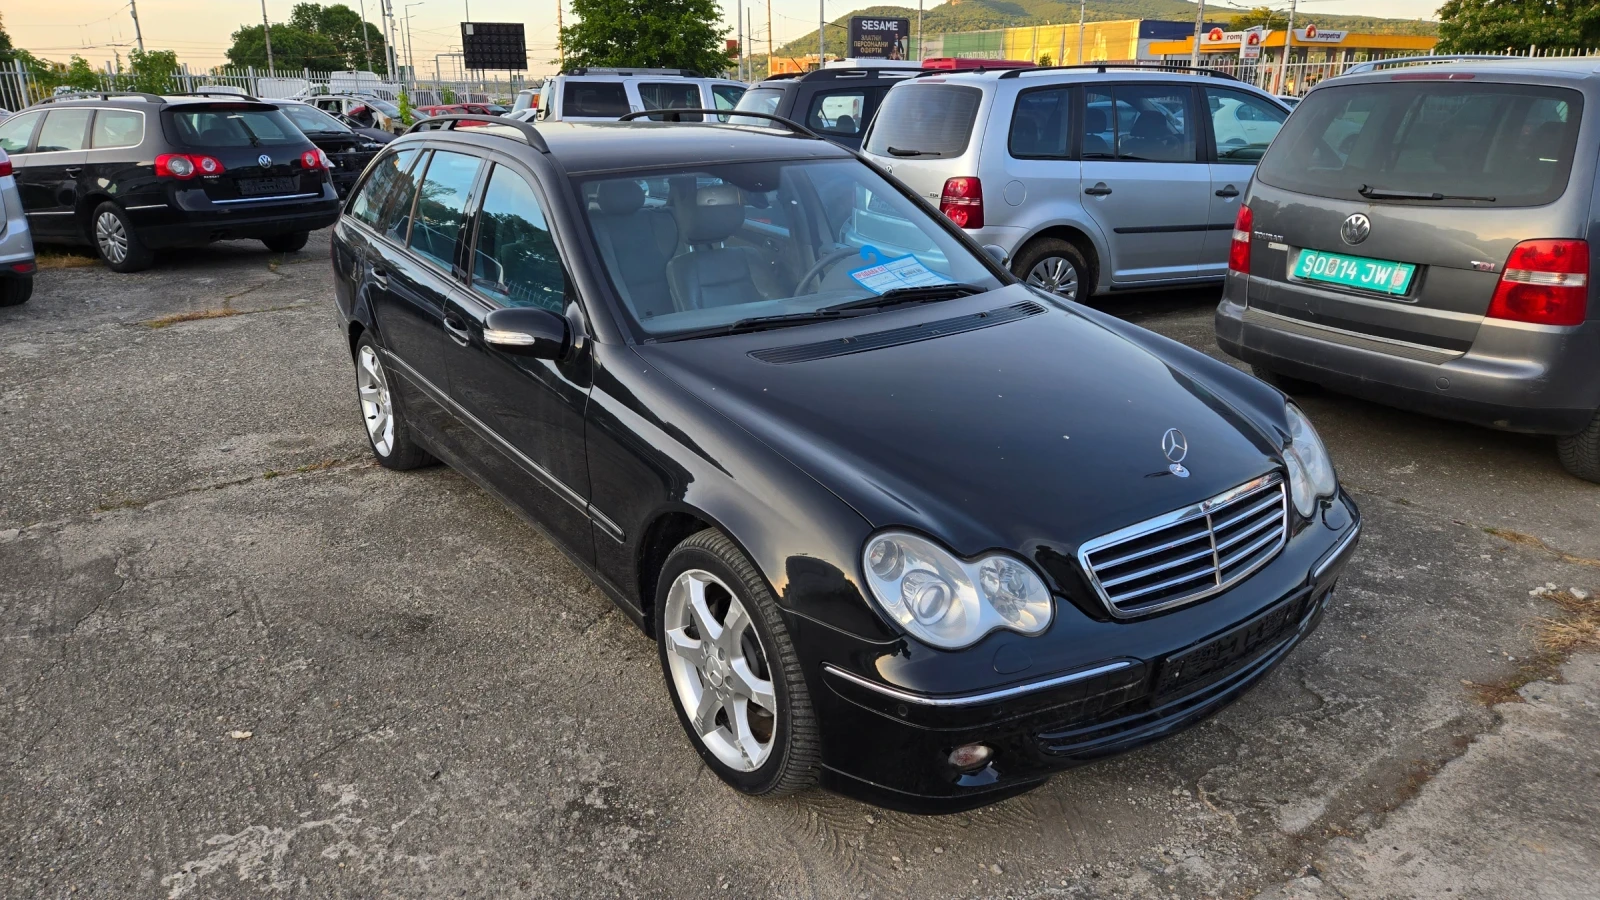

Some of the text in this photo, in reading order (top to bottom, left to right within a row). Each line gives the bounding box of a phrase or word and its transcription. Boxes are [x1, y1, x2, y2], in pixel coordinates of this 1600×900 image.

[862, 20, 898, 30] SESAME
[1318, 32, 1341, 40] rompetrol
[853, 40, 889, 48] ПЕРСОНАЛНИ
[1303, 254, 1391, 285] SO 14 JW
[1470, 261, 1495, 271] TDI
